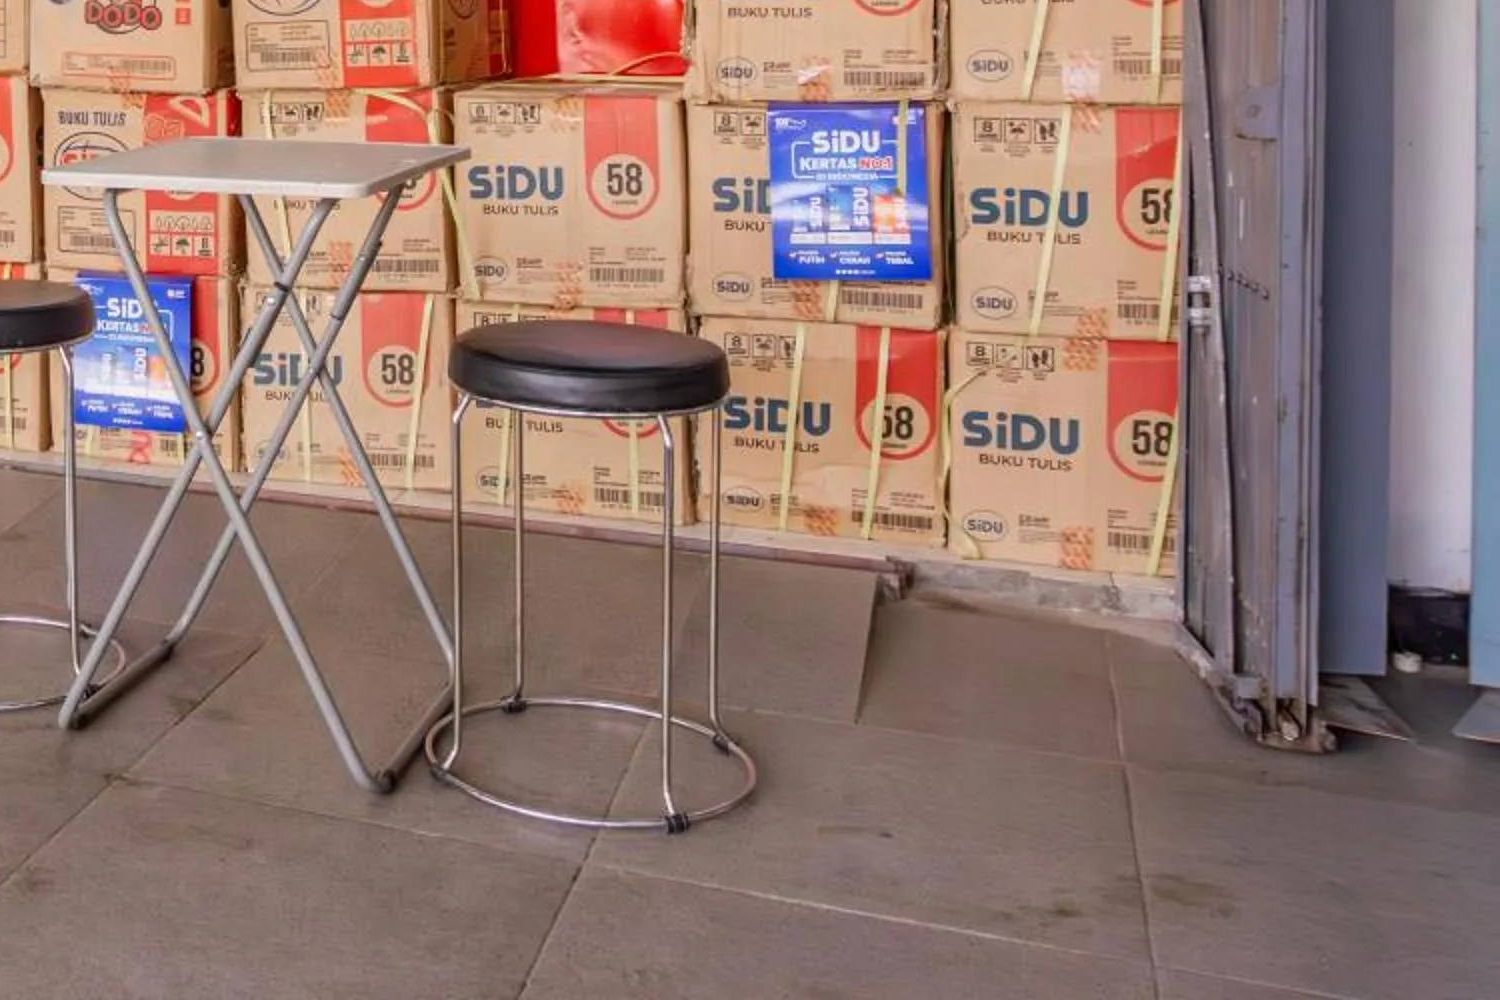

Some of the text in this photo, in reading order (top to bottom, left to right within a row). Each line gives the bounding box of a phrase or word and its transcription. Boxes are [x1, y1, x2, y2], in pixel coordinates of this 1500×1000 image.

[85, 0, 163, 31] DODO
[727, 7, 813, 18] BUKU TULIS
[972, 59, 1009, 73] SiDU
[58, 111, 127, 126] BUKU TULIS
[812, 130, 880, 154] SiDU
[800, 157, 857, 170] KERTAS
[468, 165, 563, 200] SiDU
[607, 163, 643, 196] 58
[712, 177, 771, 214] Si
[483, 204, 559, 216] BUKU TULIS
[970, 188, 1088, 228] SiDU
[724, 219, 765, 232] BUKU
[987, 231, 1082, 244] BUKU TLIS
[107, 297, 158, 318] SiD
[191, 346, 205, 377] 8
[381, 354, 414, 385] 58
[525, 419, 564, 433] TULIS
[724, 396, 831, 436] SiDU
[962, 410, 1080, 455] SiDU
[1131, 419, 1173, 457] 58
[733, 436, 820, 453] BUKU TLIS
[979, 453, 1073, 471] BUKU TULIS
[967, 519, 1003, 534] SiDU
